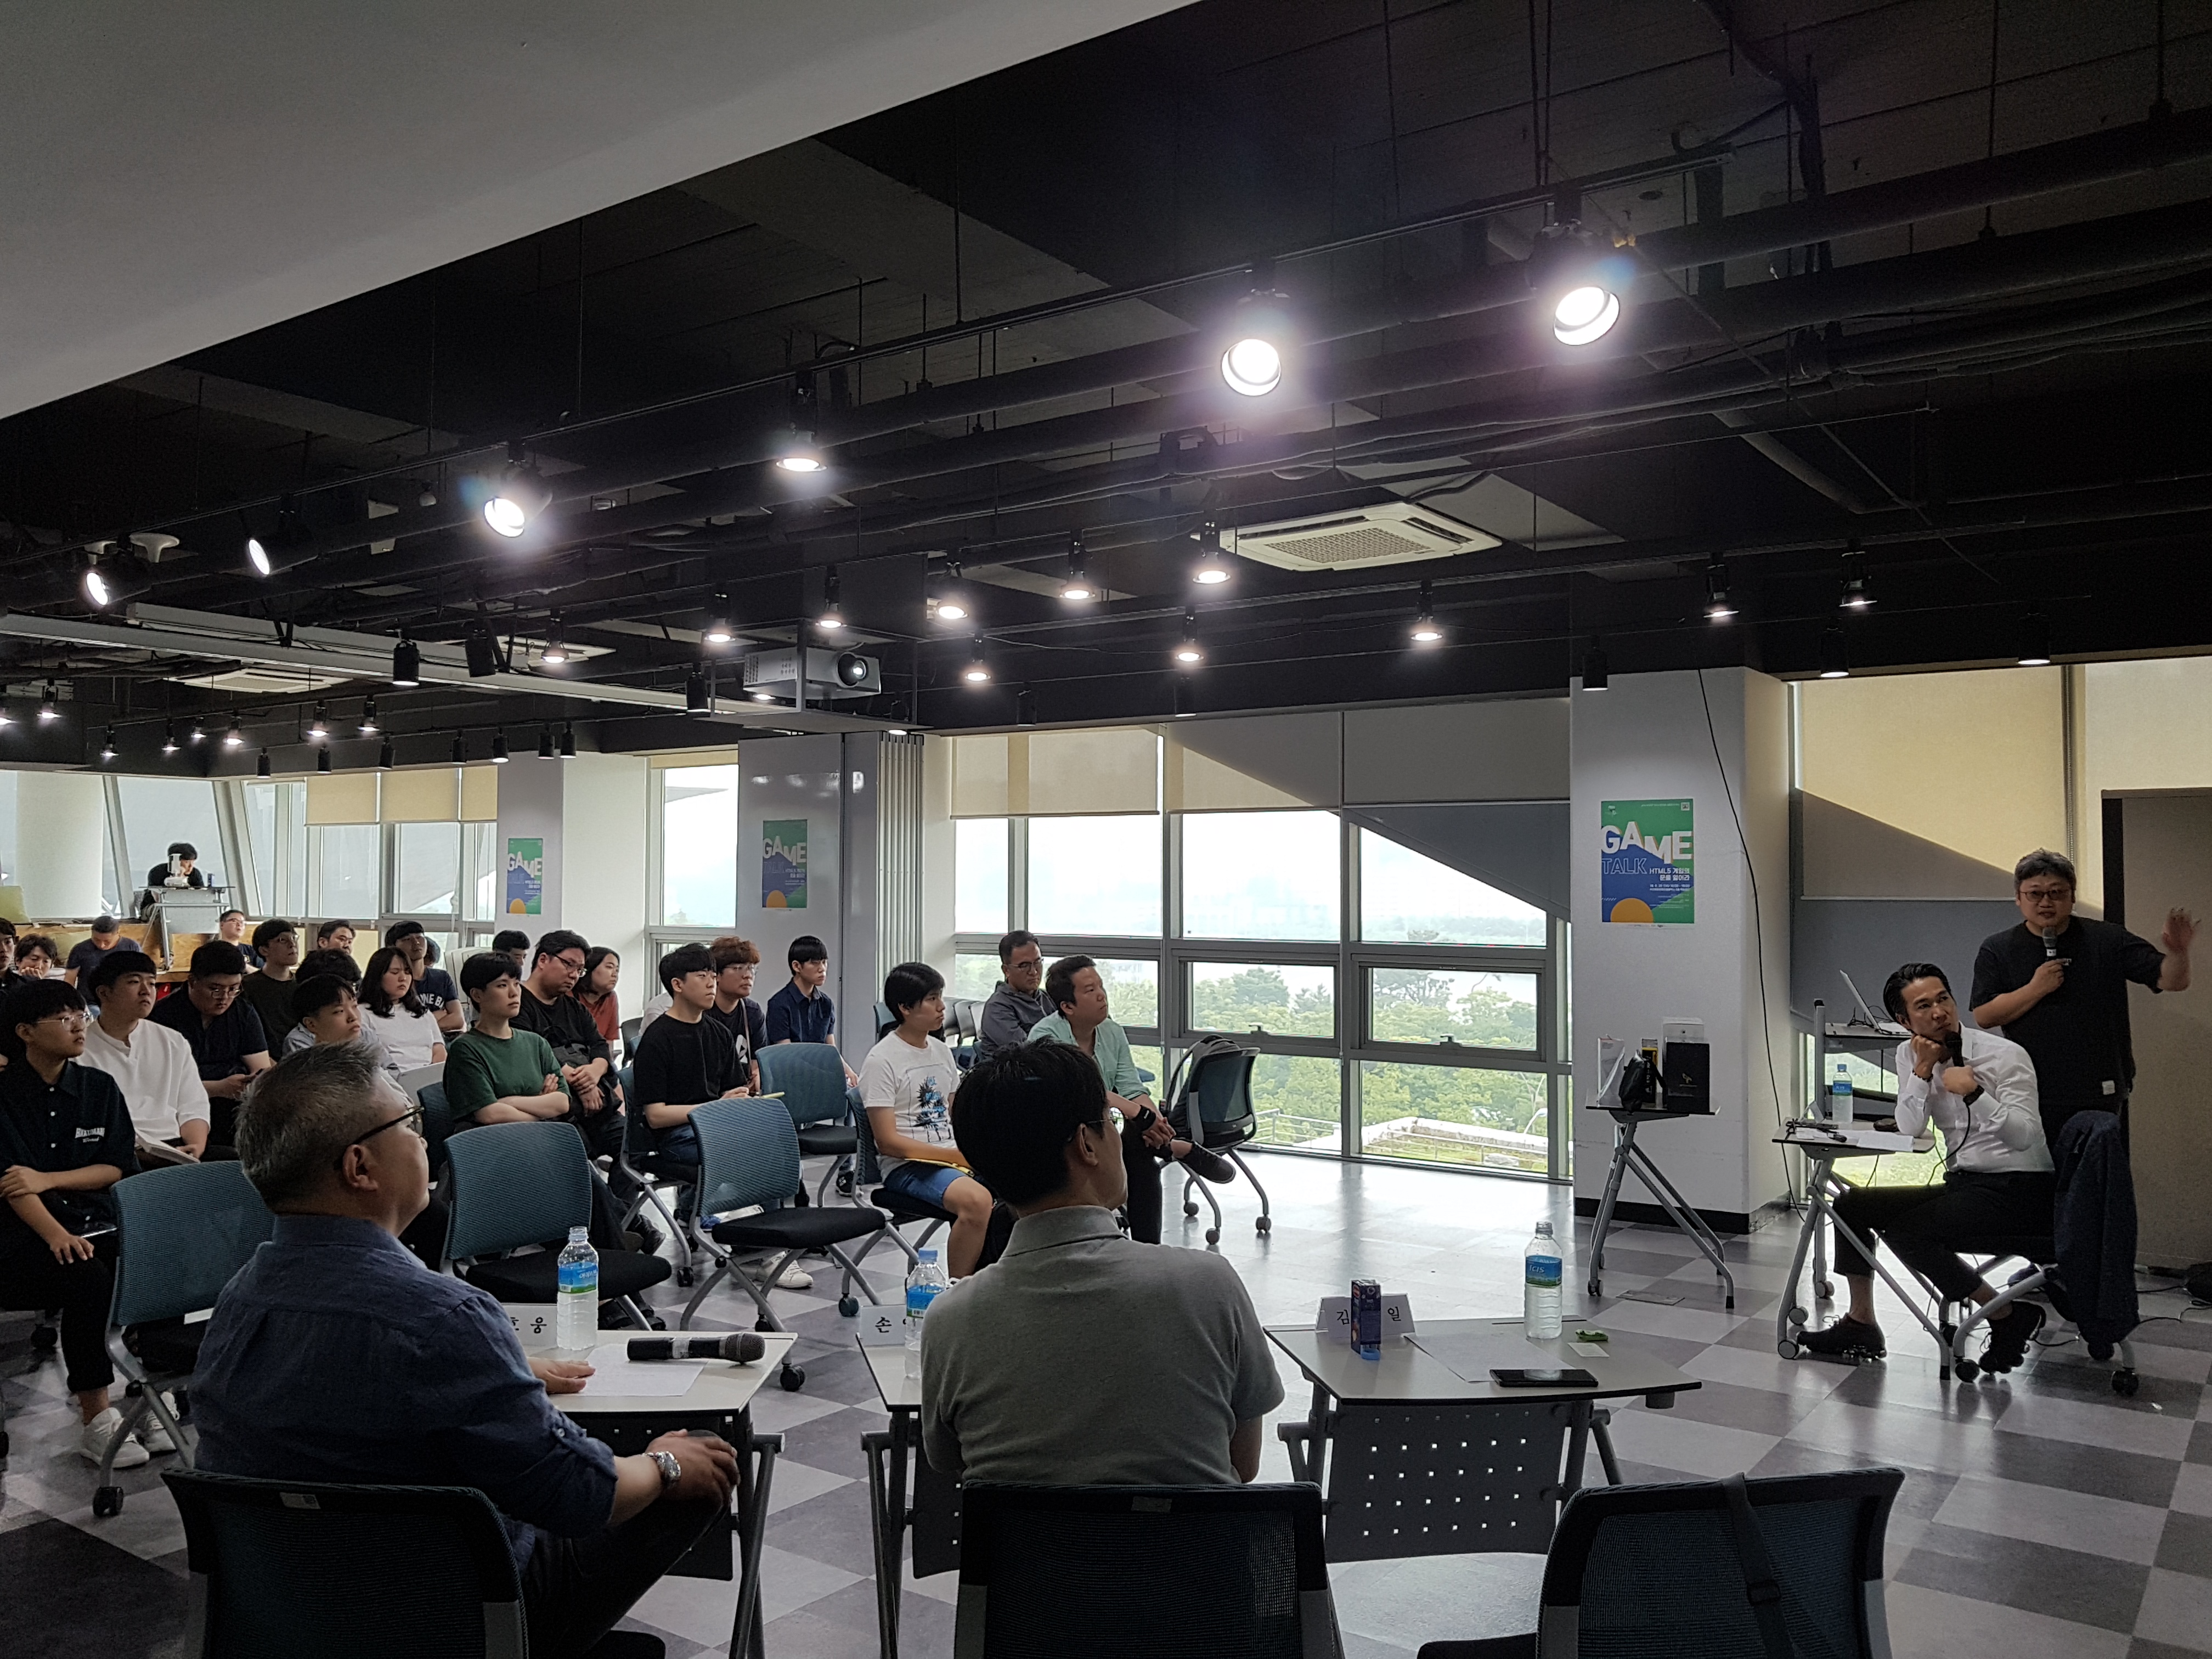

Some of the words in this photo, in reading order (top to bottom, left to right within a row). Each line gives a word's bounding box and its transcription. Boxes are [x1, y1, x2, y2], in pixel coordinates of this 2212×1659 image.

[763, 836, 806, 866] GAME
[1600, 821, 1694, 864] GAME
[507, 851, 542, 878] GAME
[1601, 858, 1647, 874] TALK
[875, 1317, 892, 1333] 손
[1336, 1309, 1350, 1325] 김
[1387, 1306, 1401, 1322] 일
[530, 1317, 547, 1334] 웅
